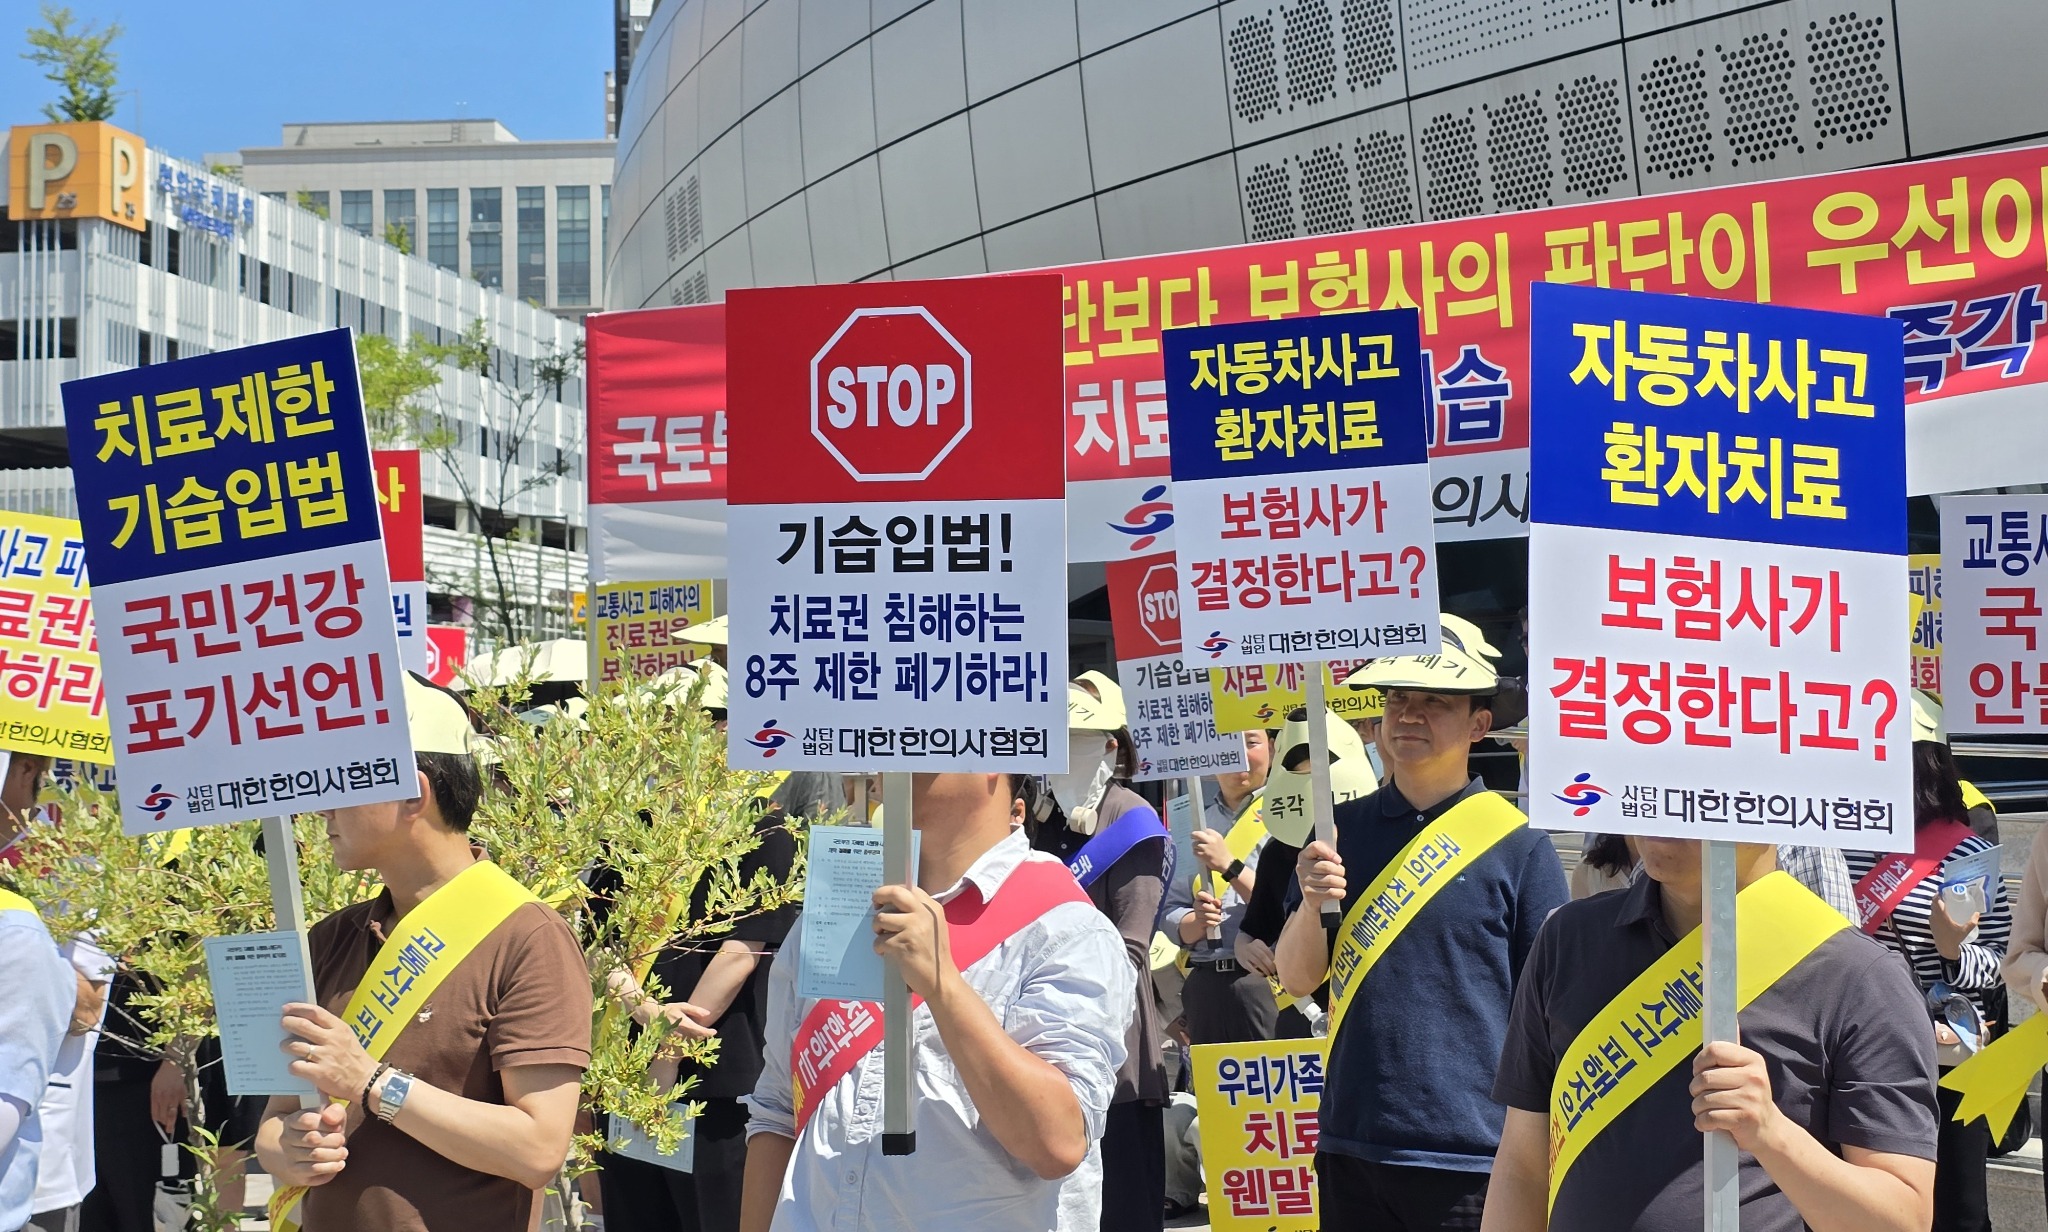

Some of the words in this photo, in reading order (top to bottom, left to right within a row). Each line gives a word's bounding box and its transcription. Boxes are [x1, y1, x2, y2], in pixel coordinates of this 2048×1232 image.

[29, 132, 77, 209] P
[112, 136, 137, 213] P
[1190, 333, 1399, 397] 자동차사고
[1569, 319, 1875, 419] 자동차사고
[94, 361, 335, 465] 치료제한
[827, 364, 956, 429] STOP
[1425, 345, 1511, 447] 습
[1214, 400, 1383, 461] 환자치료
[1601, 421, 1847, 519] 환자치료
[108, 451, 348, 554] 기습입법
[1220, 480, 1387, 539] 보험사가
[777, 513, 1012, 574] 기습입법!
[597, 590, 645, 619] 교통사고
[649, 583, 700, 614] 피해자의
[1191, 545, 1426, 612] 결정한다고?
[1601, 554, 1848, 652] 보험사가
[0, 589, 98, 652] 료권
[122, 564, 365, 664] 국민건강
[769, 593, 869, 643] 치료권
[883, 592, 1025, 642] 침해하는
[1241, 633, 1265, 644] 사단
[1269, 623, 1427, 652] 대한한의사협회
[1240, 644, 1265, 655] 법인
[745, 653, 800, 701] 8주
[813, 651, 881, 701] 제한
[894, 651, 1048, 702] 폐기하라!
[126, 653, 389, 754] 포기선언!
[1138, 696, 1173, 722] 치료권
[1550, 656, 1898, 762] 결정한다고?
[803, 727, 834, 741] 사단
[803, 742, 834, 757] 법인
[839, 726, 1047, 758] 대한한의사협회
[1132, 728, 1153, 750] 8주
[1156, 722, 1180, 747] 제한
[187, 784, 213, 799] 사단
[187, 798, 215, 813] 법인
[218, 758, 400, 809] 대한한의사협회
[1270, 794, 1304, 819] 즉각
[1621, 801, 1658, 818] 법인
[1622, 784, 1658, 801] 사단
[1664, 787, 1893, 834] 대한한의사협회
[1403, 832, 1461, 887] 국민의
[1869, 859, 1914, 902] 치료권
[371, 927, 446, 1014] 교통사고
[1218, 1054, 1324, 1106] 우리가족
[1558, 1034, 1638, 1133] 피해자의
[1223, 1166, 1313, 1216] 웬말
